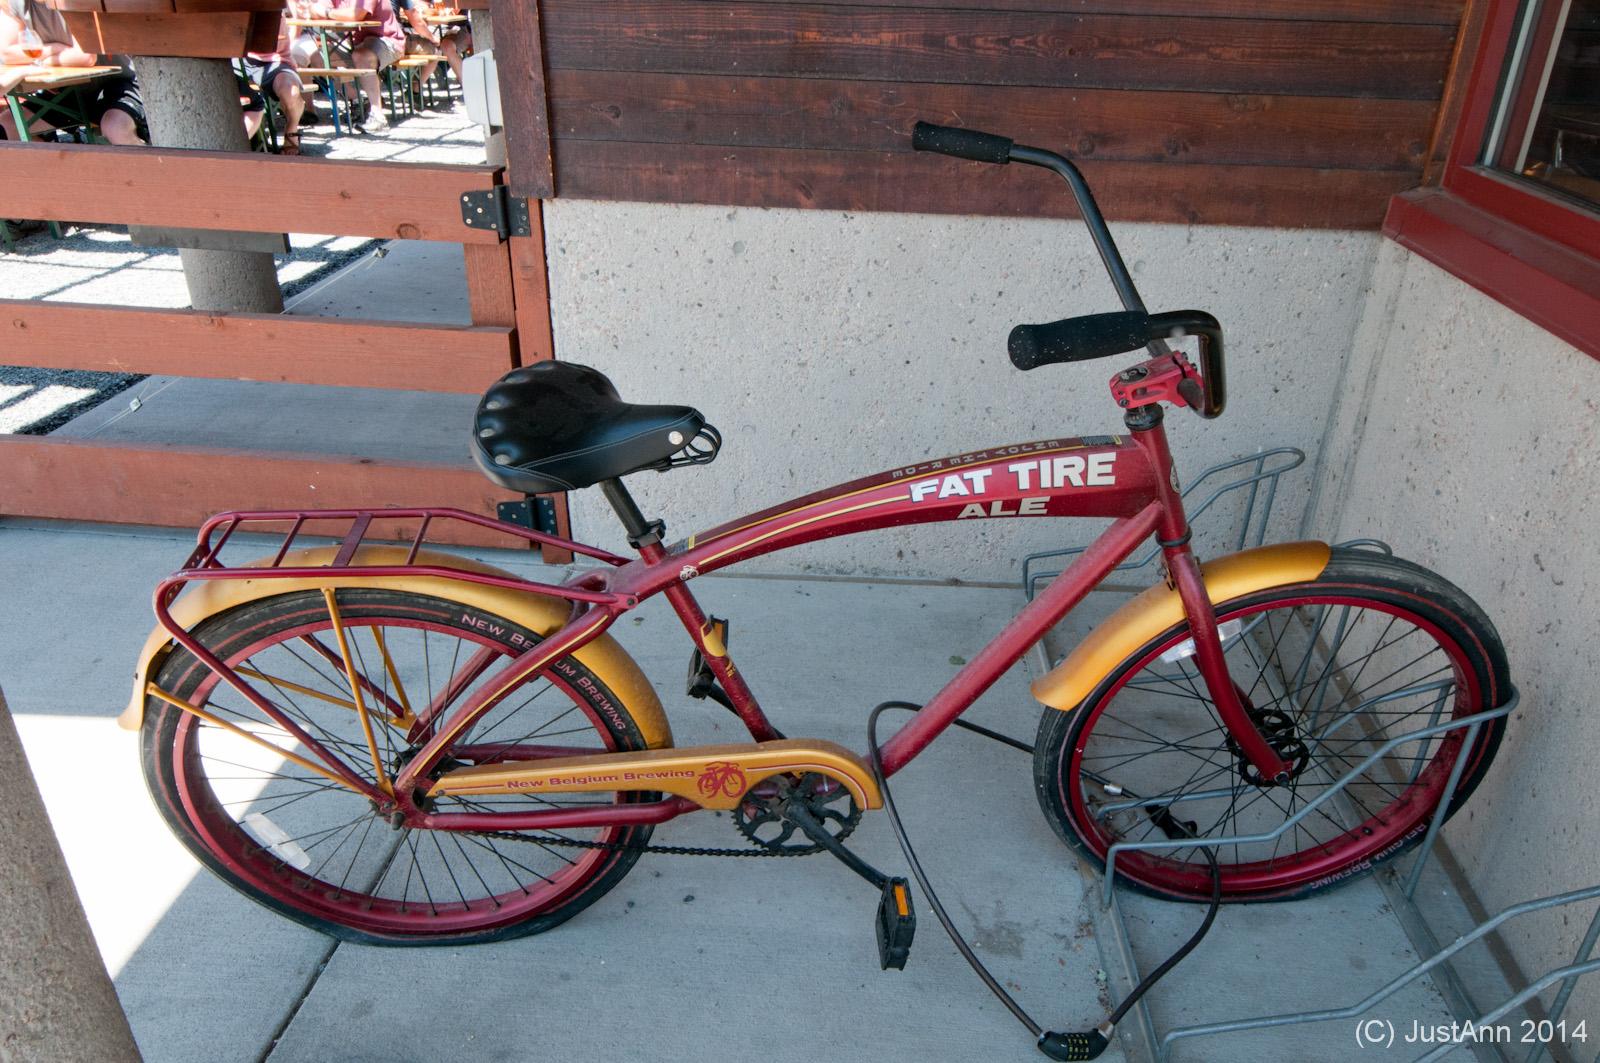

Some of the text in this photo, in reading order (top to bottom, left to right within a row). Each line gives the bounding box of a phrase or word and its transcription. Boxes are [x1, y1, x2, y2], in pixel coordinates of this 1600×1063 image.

[893, 441, 1059, 478] ENJOY THE RIDE
[910, 452, 1116, 502] FAT TIRE
[957, 496, 1051, 519] ALE
[461, 614, 505, 636] NEW
[577, 677, 626, 731] BREWING
[507, 770, 695, 789] New Belgium Brewing
